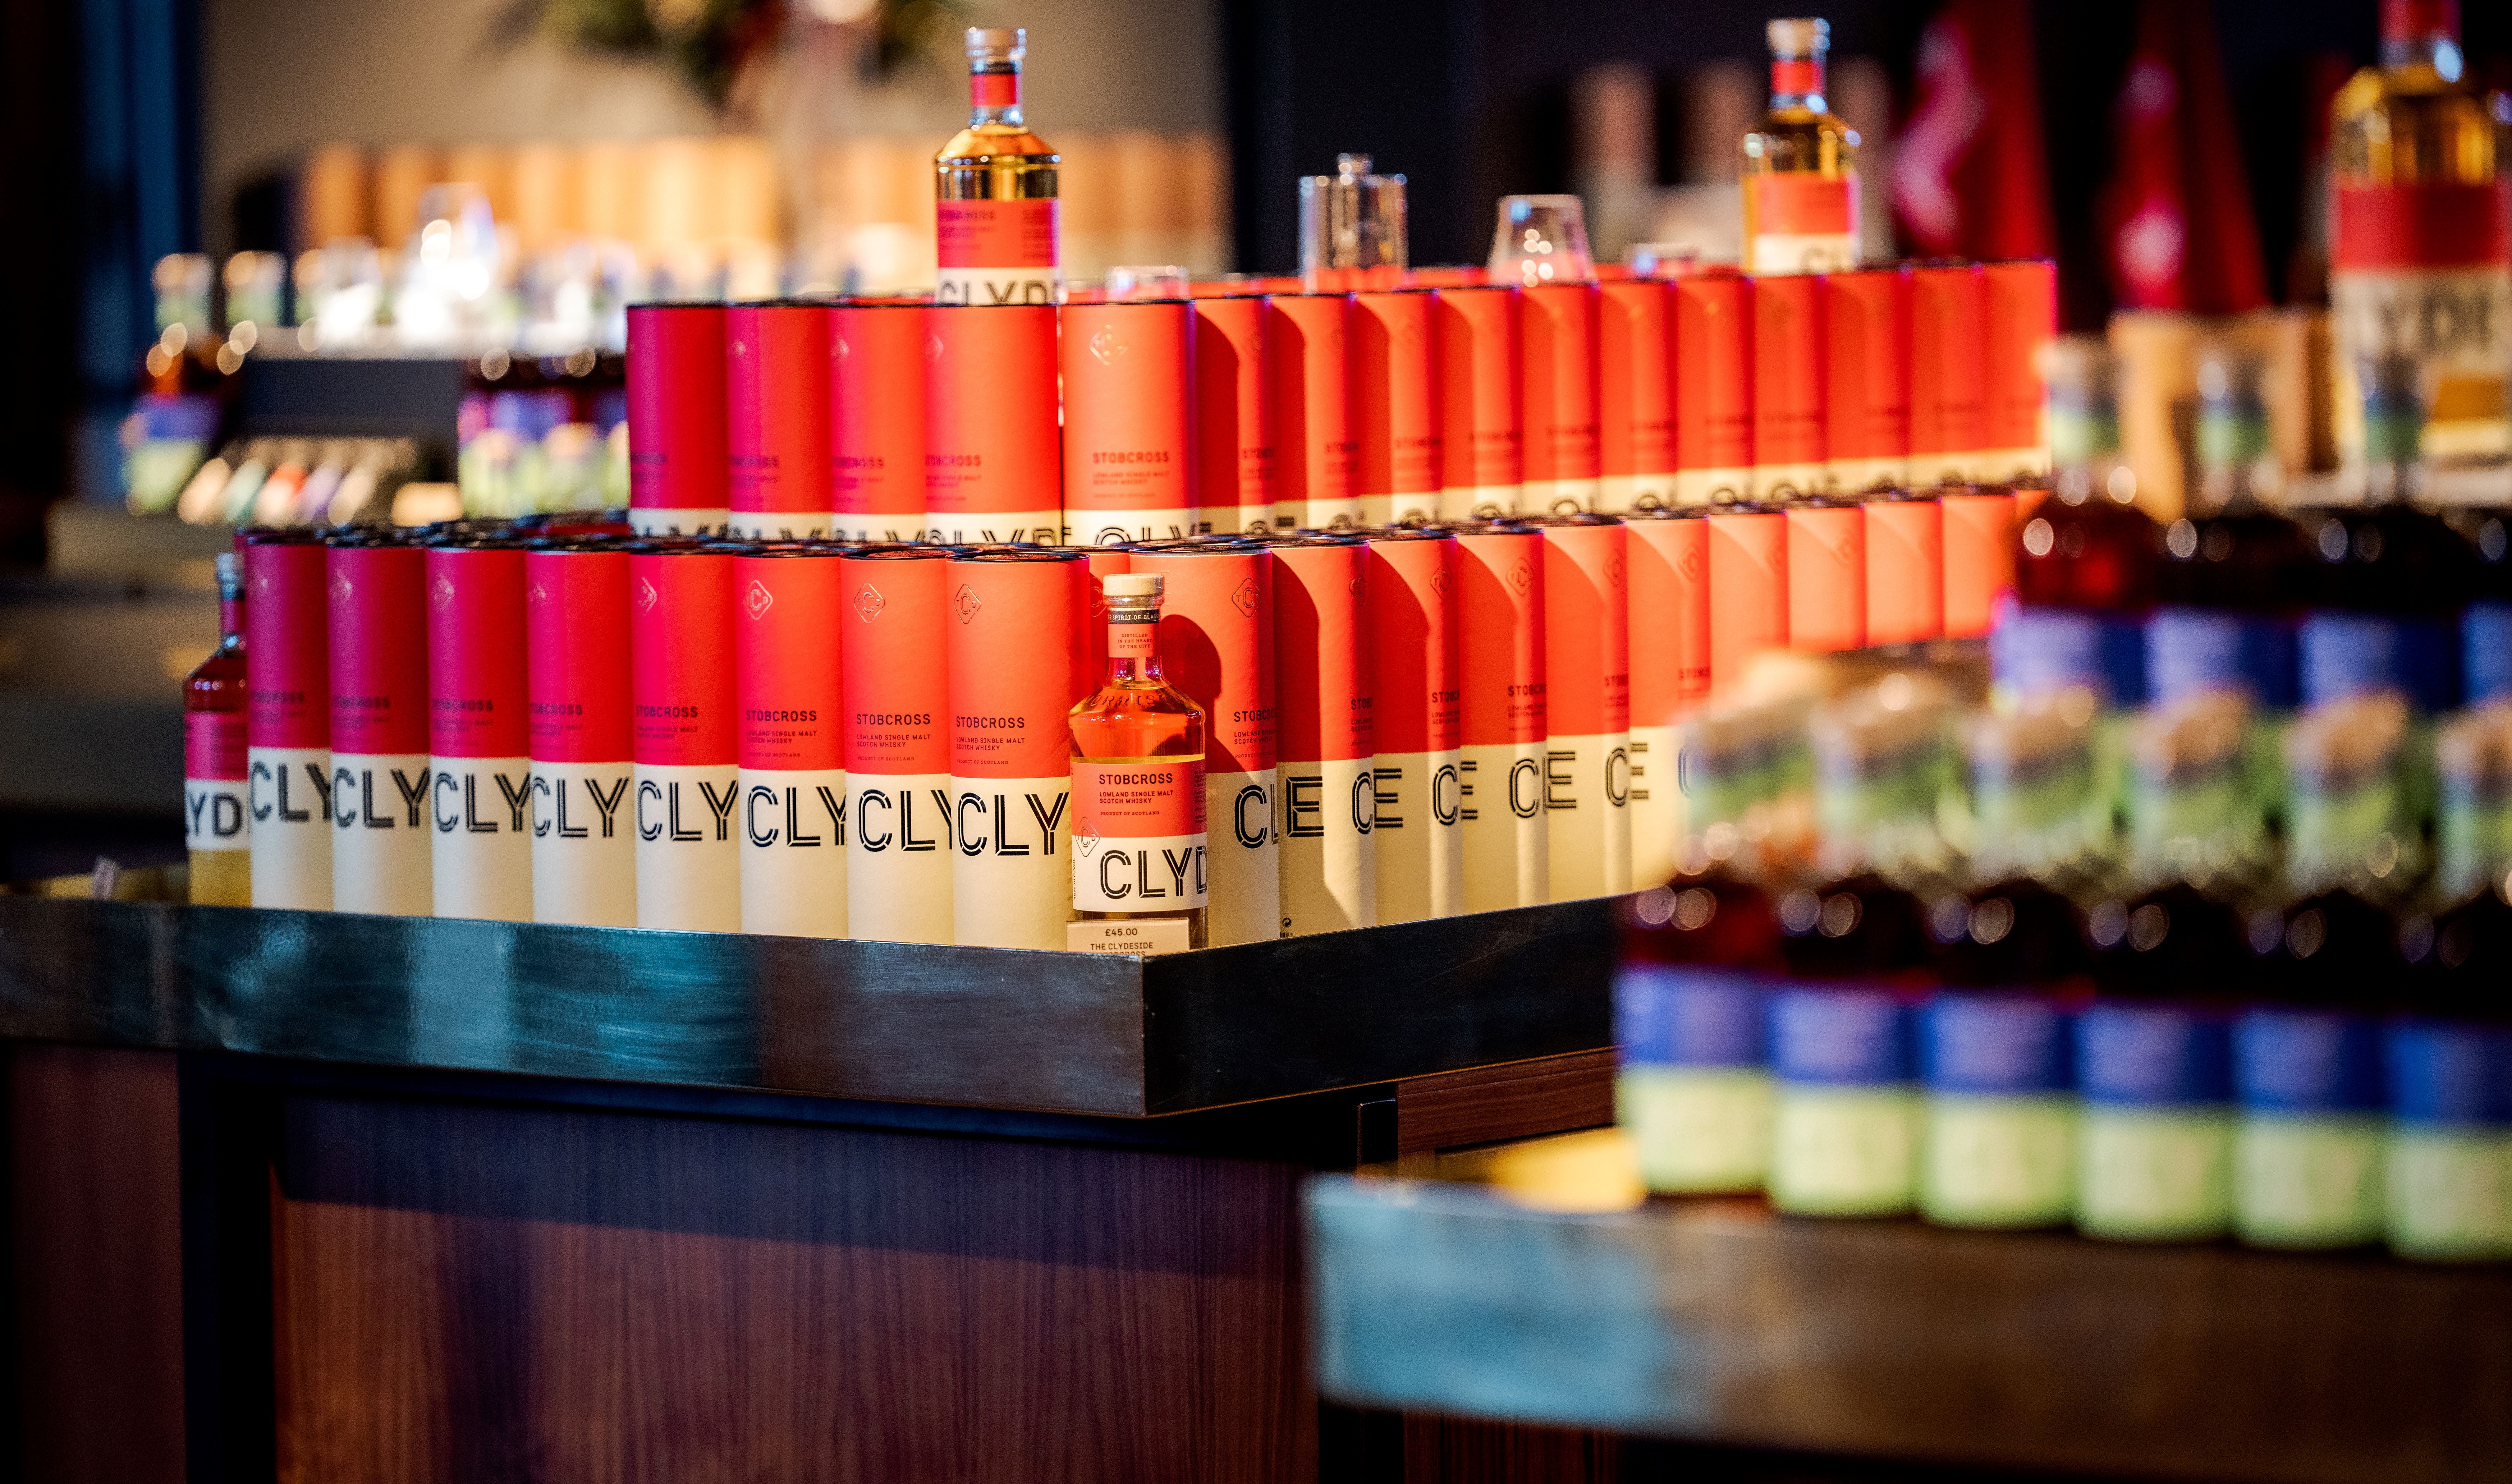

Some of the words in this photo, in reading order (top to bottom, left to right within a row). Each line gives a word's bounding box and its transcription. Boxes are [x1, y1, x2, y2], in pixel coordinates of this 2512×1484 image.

[746, 710, 817, 722] STOBCROSS
[857, 713, 930, 725] STOBCROSS
[956, 716, 1024, 728] STOBCROSS
[1099, 773, 1173, 785] STOBCROSS
[435, 771, 530, 833] CLY
[532, 776, 629, 837] CLY
[638, 779, 738, 841] CLY
[958, 792, 1069, 856] CLY
